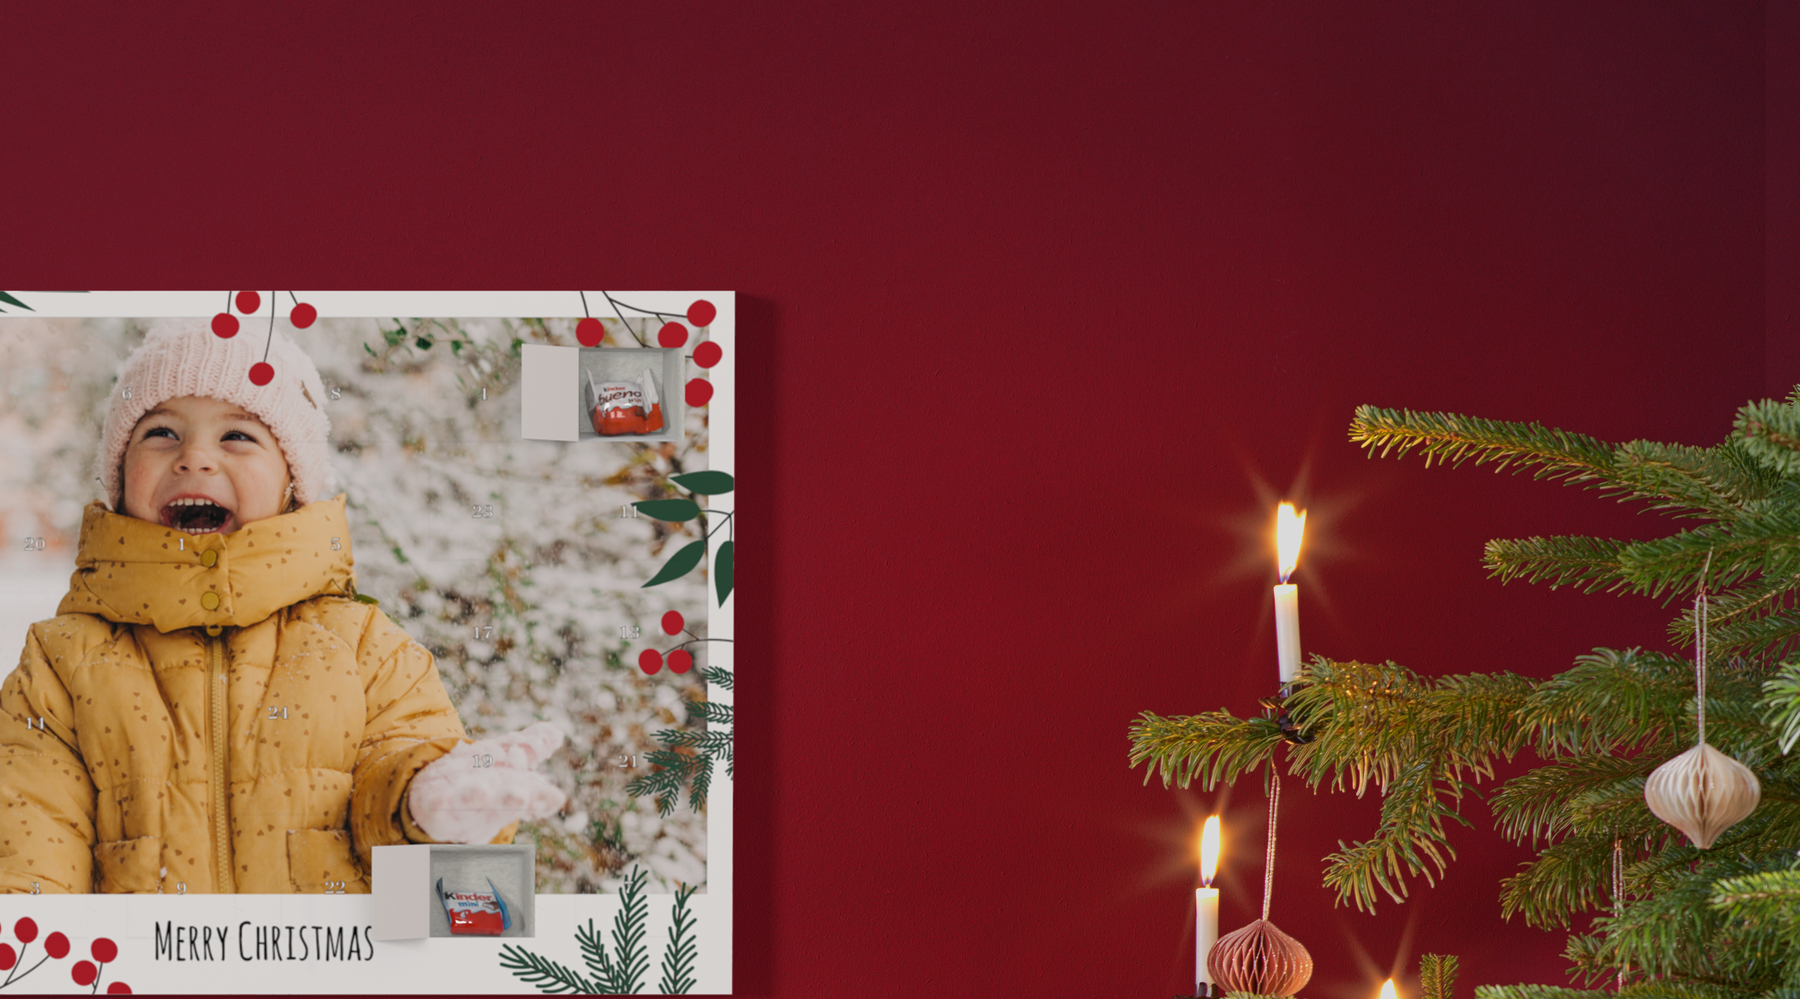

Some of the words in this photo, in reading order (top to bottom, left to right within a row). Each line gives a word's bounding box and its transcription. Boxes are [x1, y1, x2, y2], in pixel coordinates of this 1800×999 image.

[121, 387, 133, 401] 6
[330, 387, 341, 401] 8
[478, 387, 489, 401] 4
[598, 390, 642, 406] bueno
[472, 505, 494, 518] 23
[620, 505, 639, 518] 11
[24, 537, 46, 551] 20
[178, 537, 186, 551] 1
[330, 537, 341, 551] 5
[473, 626, 493, 640] 17
[620, 626, 640, 640] 13
[268, 706, 289, 720] 24
[25, 716, 46, 730] 14
[472, 755, 493, 768] 19
[618, 755, 639, 768] 21
[30, 881, 41, 895] 3
[176, 881, 187, 895] 9
[324, 880, 346, 894] 22
